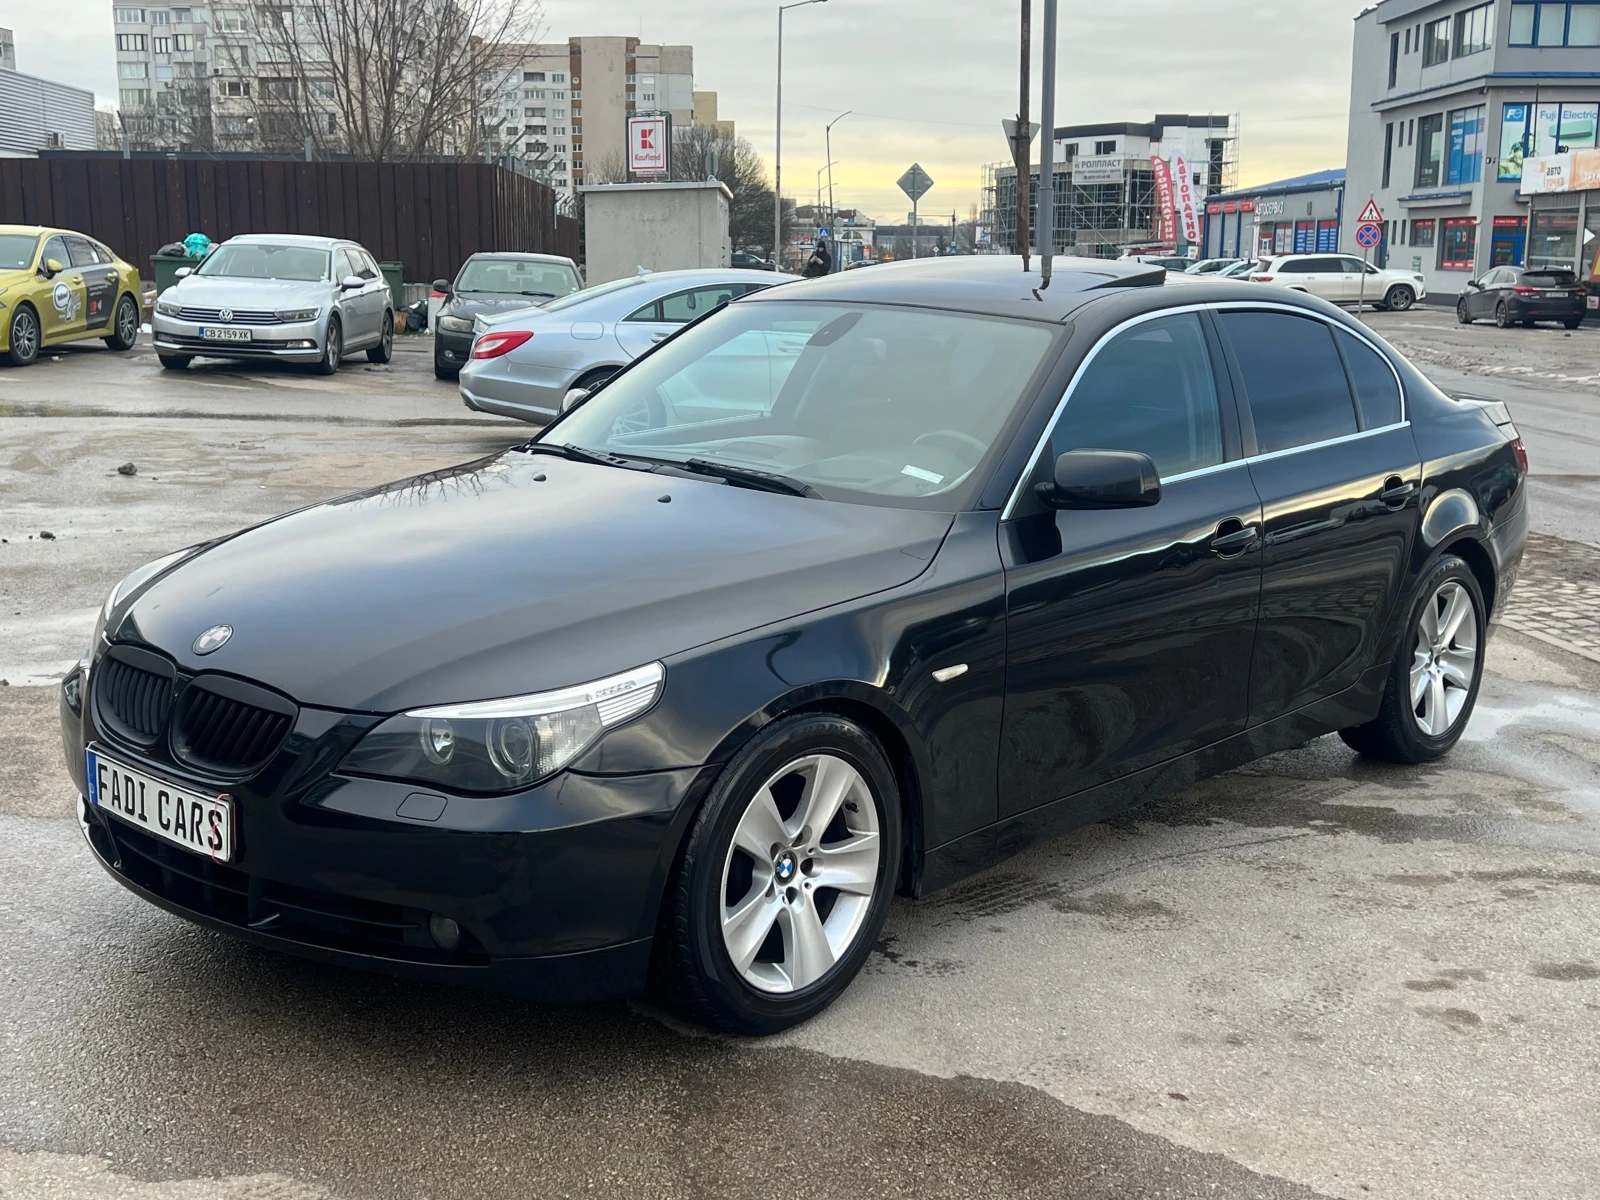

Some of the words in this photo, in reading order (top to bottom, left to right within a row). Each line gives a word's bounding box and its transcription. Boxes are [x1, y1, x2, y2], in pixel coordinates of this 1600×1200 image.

[1540, 110, 1557, 121] Fuji
[1563, 110, 1598, 119] Electric
[635, 153, 661, 161] Kaufland
[1081, 159, 1122, 169] РОЛПЛАСТ
[1176, 156, 1197, 240] АВТОПАРНО
[205, 329, 216, 338] CB
[217, 329, 238, 339] 2159
[238, 330, 249, 340] XK
[97, 762, 148, 823] FADI
[157, 790, 223, 851] CARS
